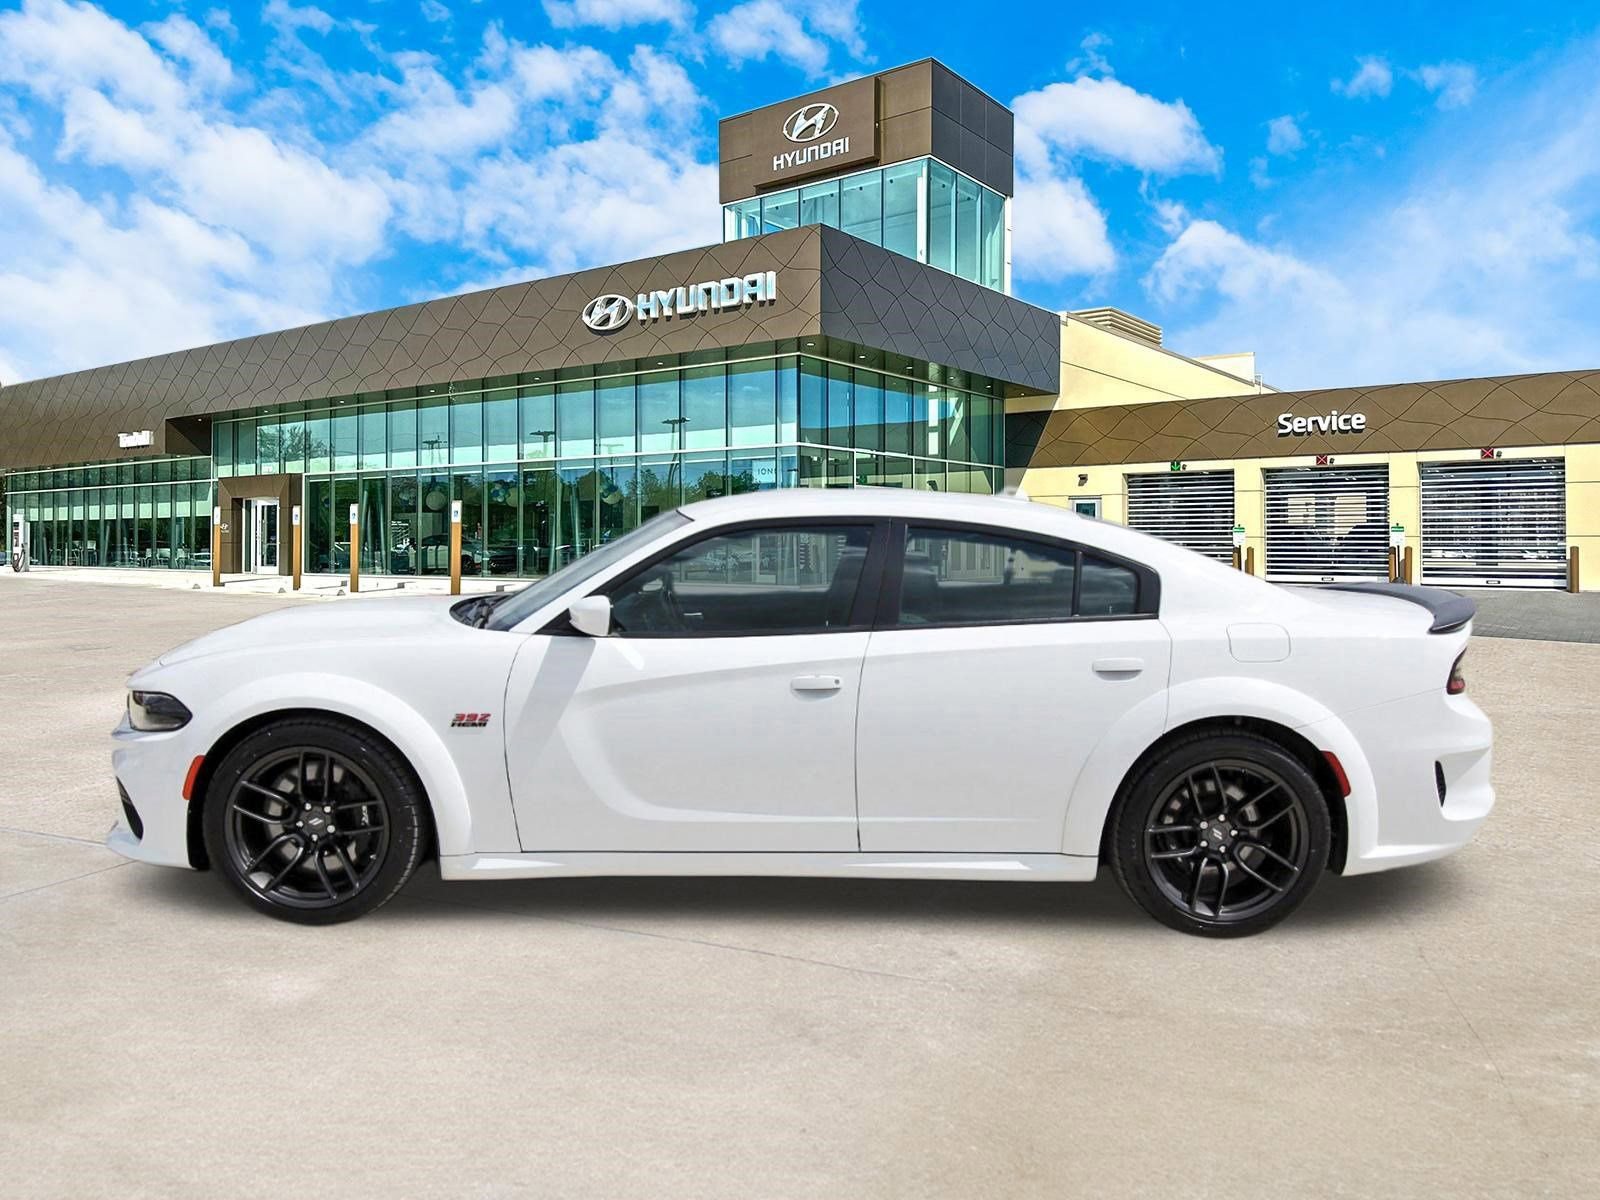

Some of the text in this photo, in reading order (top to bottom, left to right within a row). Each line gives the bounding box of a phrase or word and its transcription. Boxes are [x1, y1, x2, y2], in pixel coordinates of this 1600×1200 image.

[773, 136, 850, 171] HYUNDAI
[635, 270, 777, 321] HYUNDAI
[1277, 410, 1367, 435] Service
[452, 713, 492, 722] 392
